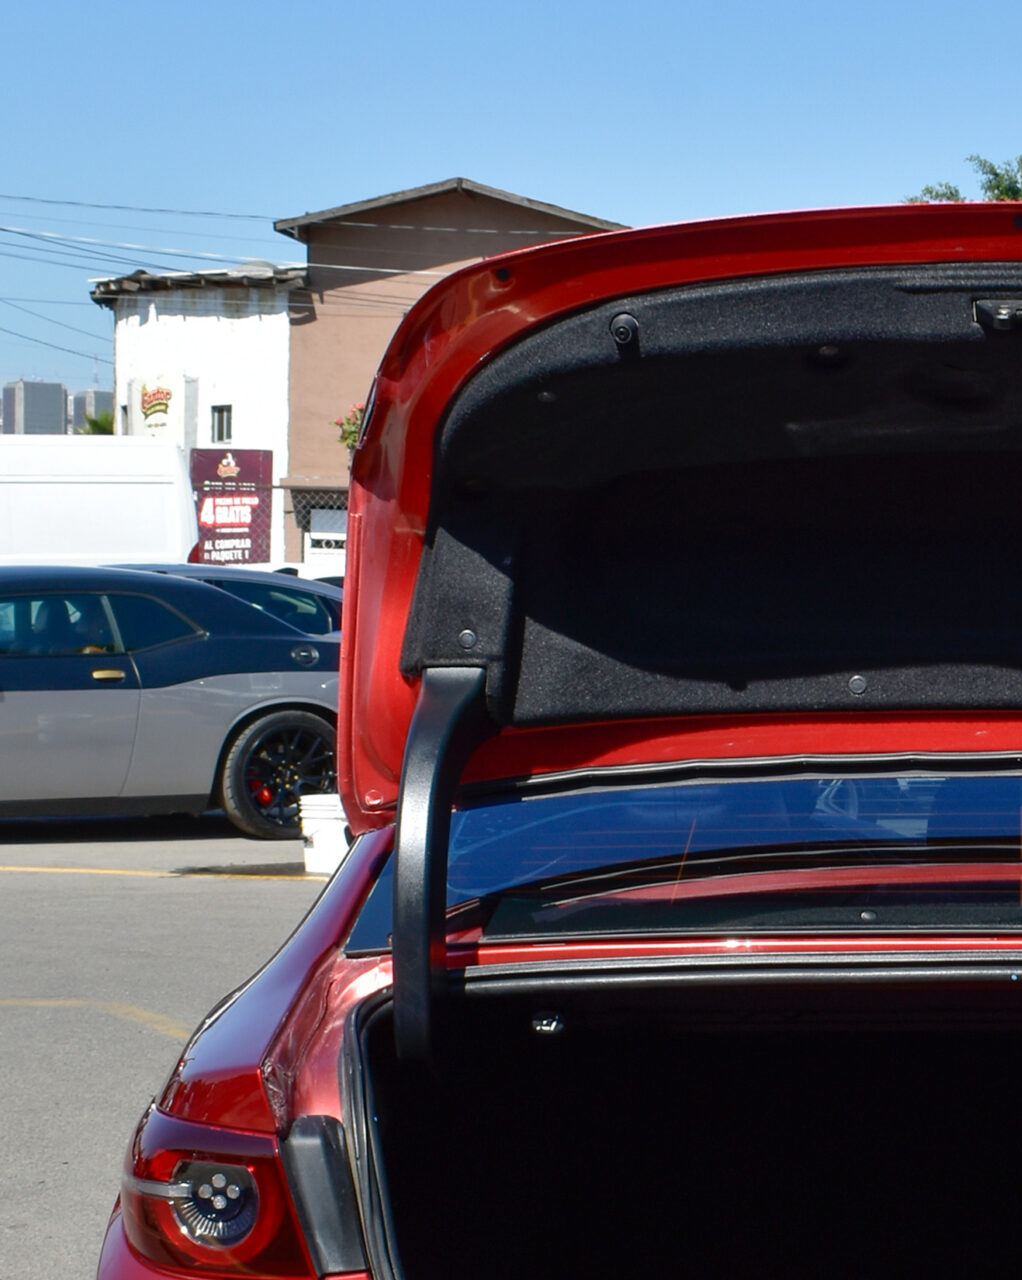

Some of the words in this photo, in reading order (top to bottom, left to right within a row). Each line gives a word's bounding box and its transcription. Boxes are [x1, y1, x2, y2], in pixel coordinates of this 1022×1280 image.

[201, 498, 214, 524] 4
[215, 505, 251, 524] GRATIS
[204, 540, 213, 549] AL
[215, 539, 251, 549] COMPRAR
[211, 551, 242, 561] PAQUETE
